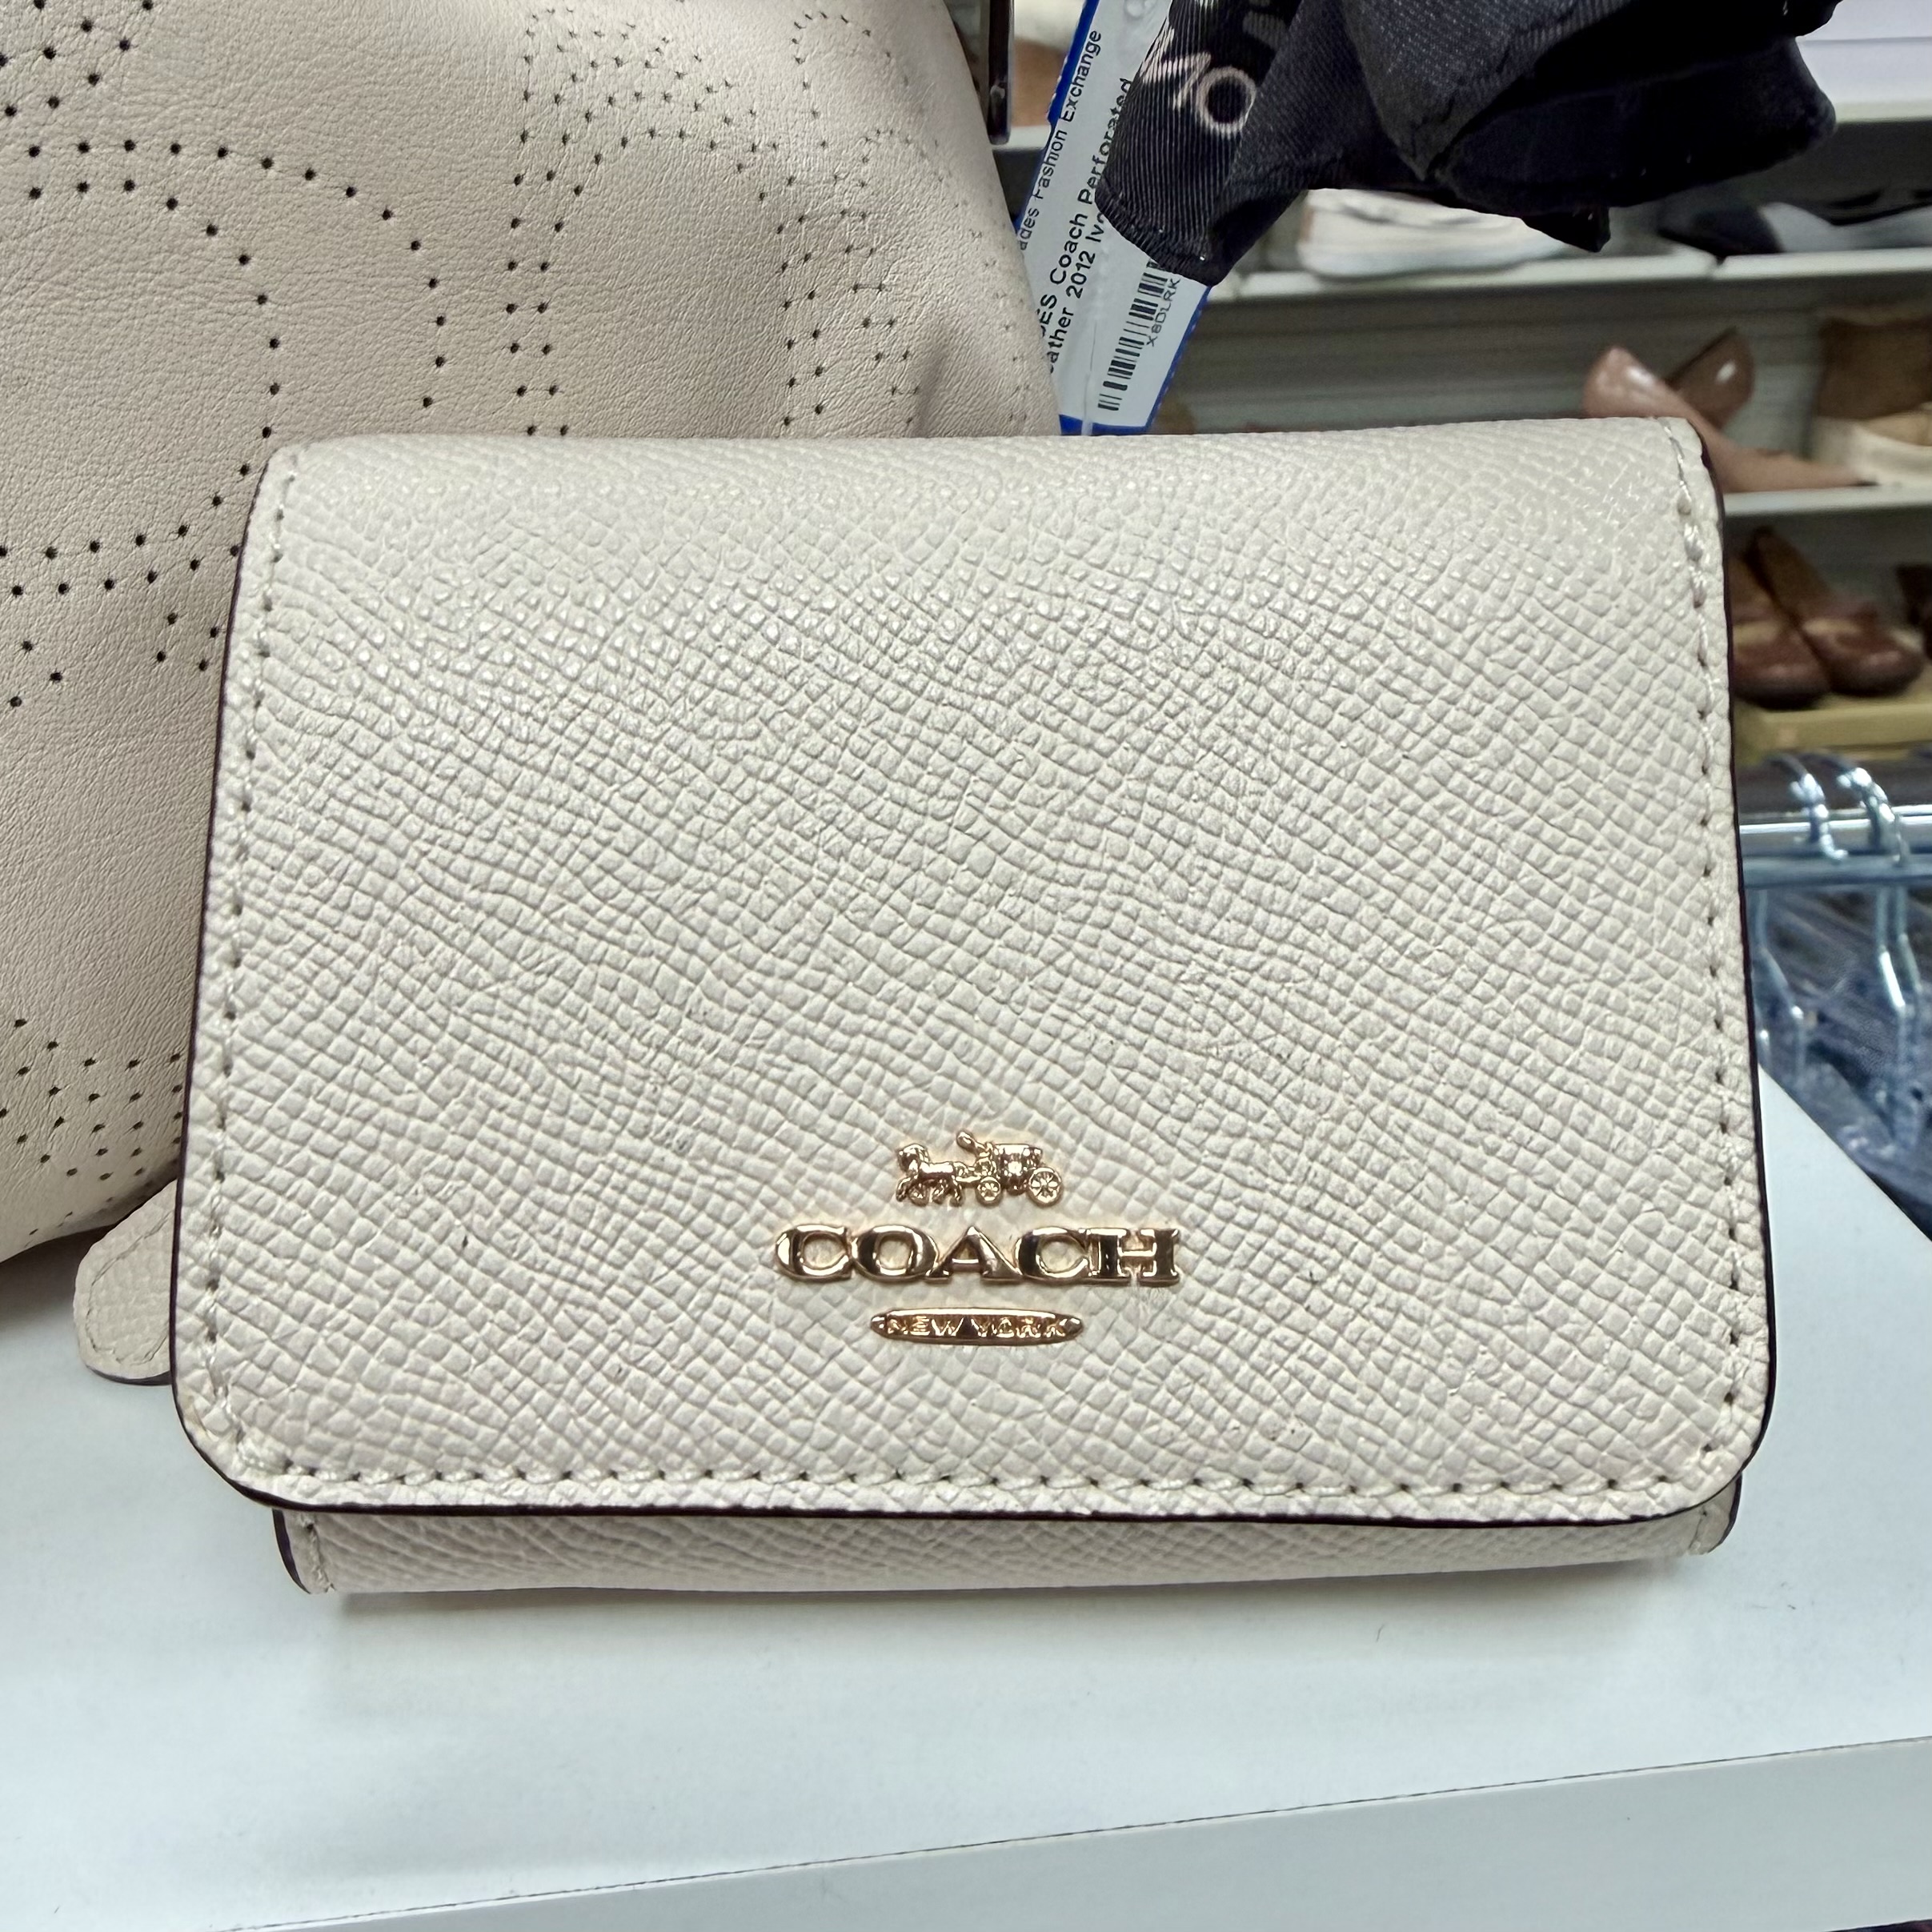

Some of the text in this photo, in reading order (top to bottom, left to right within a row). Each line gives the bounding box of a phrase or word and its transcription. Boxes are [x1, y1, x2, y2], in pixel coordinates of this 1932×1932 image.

[1019, 30, 1102, 251] ades Fashion Exchange
[1036, 294, 1057, 337] ES
[1049, 213, 1088, 285] Coach
[1047, 307, 1074, 374] ather
[1065, 251, 1096, 299] 2012
[775, 1224, 1183, 1283] COACH
[885, 1314, 965, 1338] NEW
